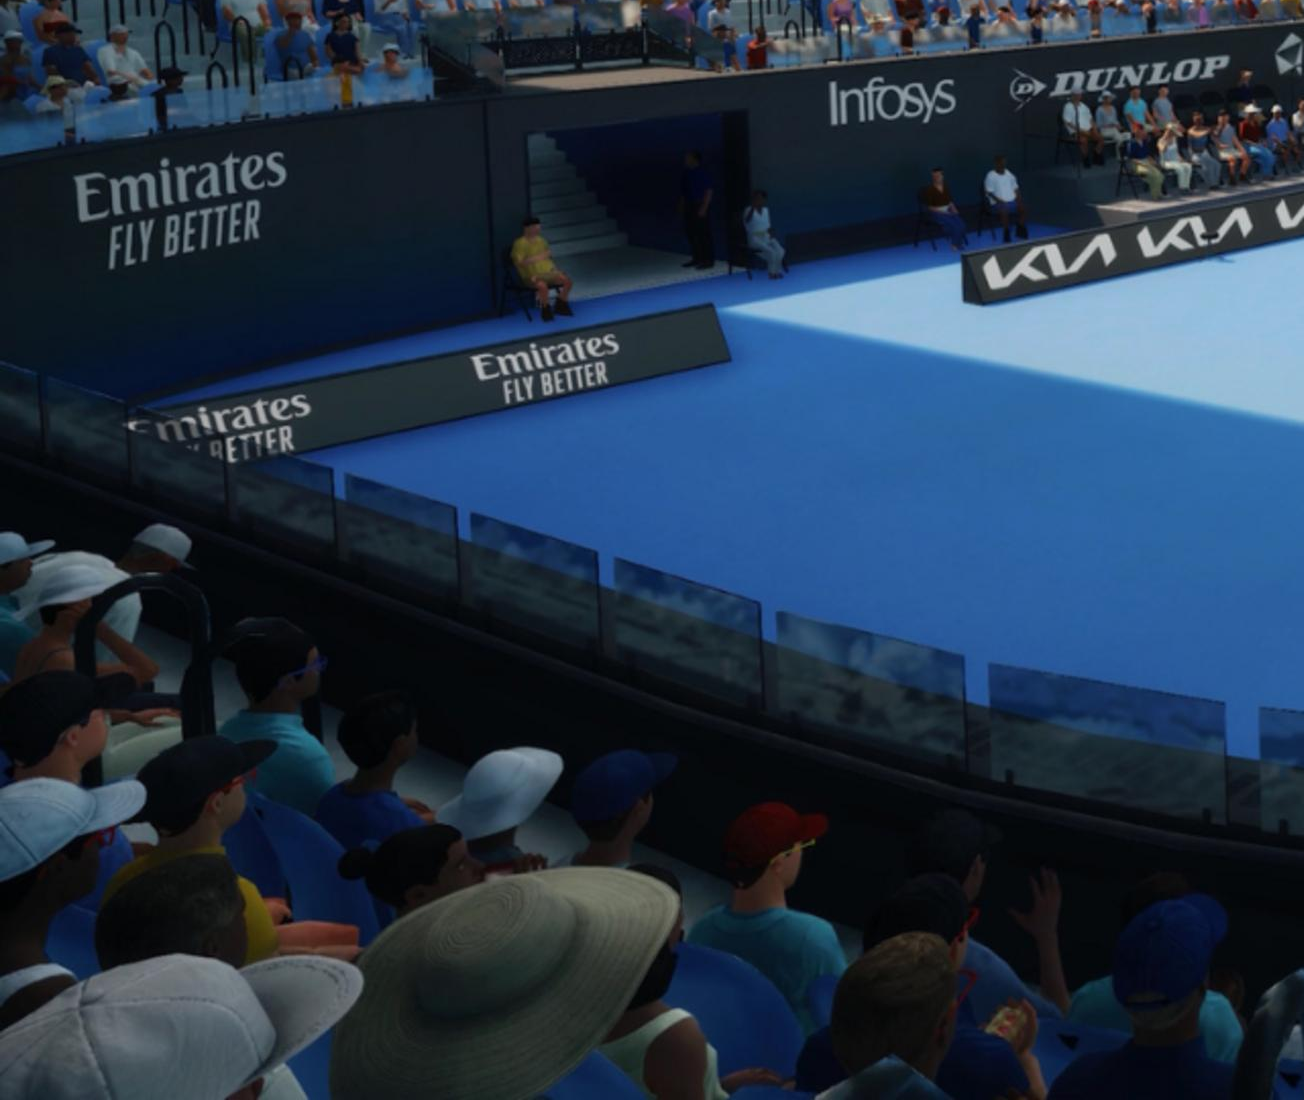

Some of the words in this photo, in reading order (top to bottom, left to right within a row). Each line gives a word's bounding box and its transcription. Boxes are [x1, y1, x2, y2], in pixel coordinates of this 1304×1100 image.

[829, 76, 956, 126] Infosys
[1050, 55, 1230, 97] DUNLOP
[73, 151, 287, 223] Emirates
[109, 219, 154, 270] FLY
[164, 199, 260, 258] BETTER
[1137, 207, 1253, 258] KIA
[983, 233, 1118, 290] KIA
[470, 333, 620, 381] Emirates
[503, 376, 534, 404] FLY
[541, 362, 608, 396] BETTER
